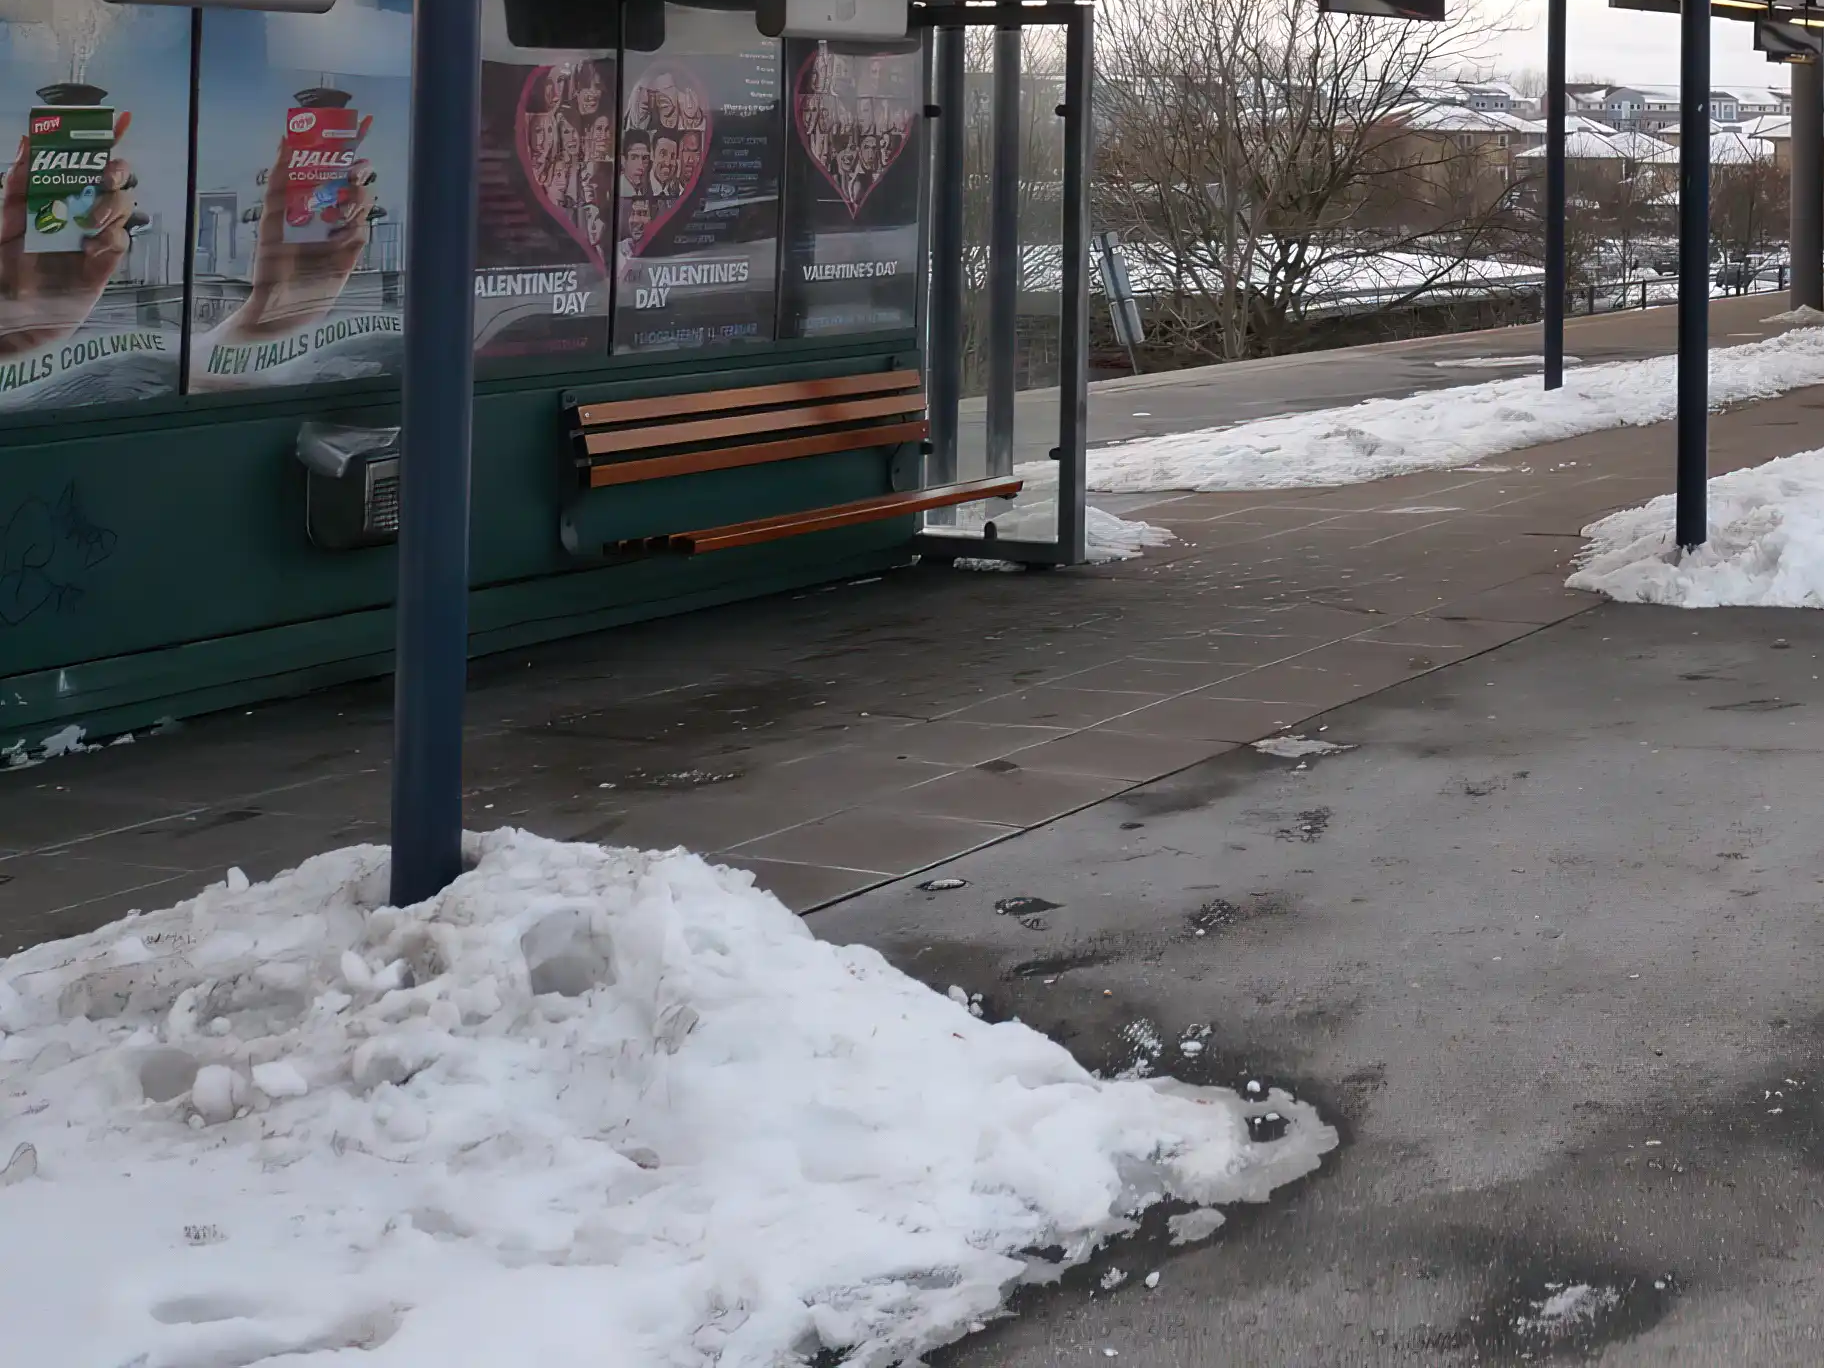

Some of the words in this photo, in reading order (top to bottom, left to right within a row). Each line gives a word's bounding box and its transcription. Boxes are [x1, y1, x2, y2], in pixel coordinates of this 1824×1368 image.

[30, 150, 109, 173] HALLS
[287, 149, 354, 169] HALLS
[32, 173, 102, 185] coolwave
[648, 261, 750, 288] VALENTINE'S
[802, 261, 874, 282] VALENTINE'S
[875, 260, 898, 278] DAY
[474, 270, 578, 297] ALENTINE'S
[552, 291, 592, 315] DAY
[635, 287, 671, 310] DAY
[60, 332, 167, 371] COOLWAVE
[207, 344, 251, 376] NEW
[254, 334, 309, 373] HALLS
[314, 315, 402, 350] COOLWAVE
